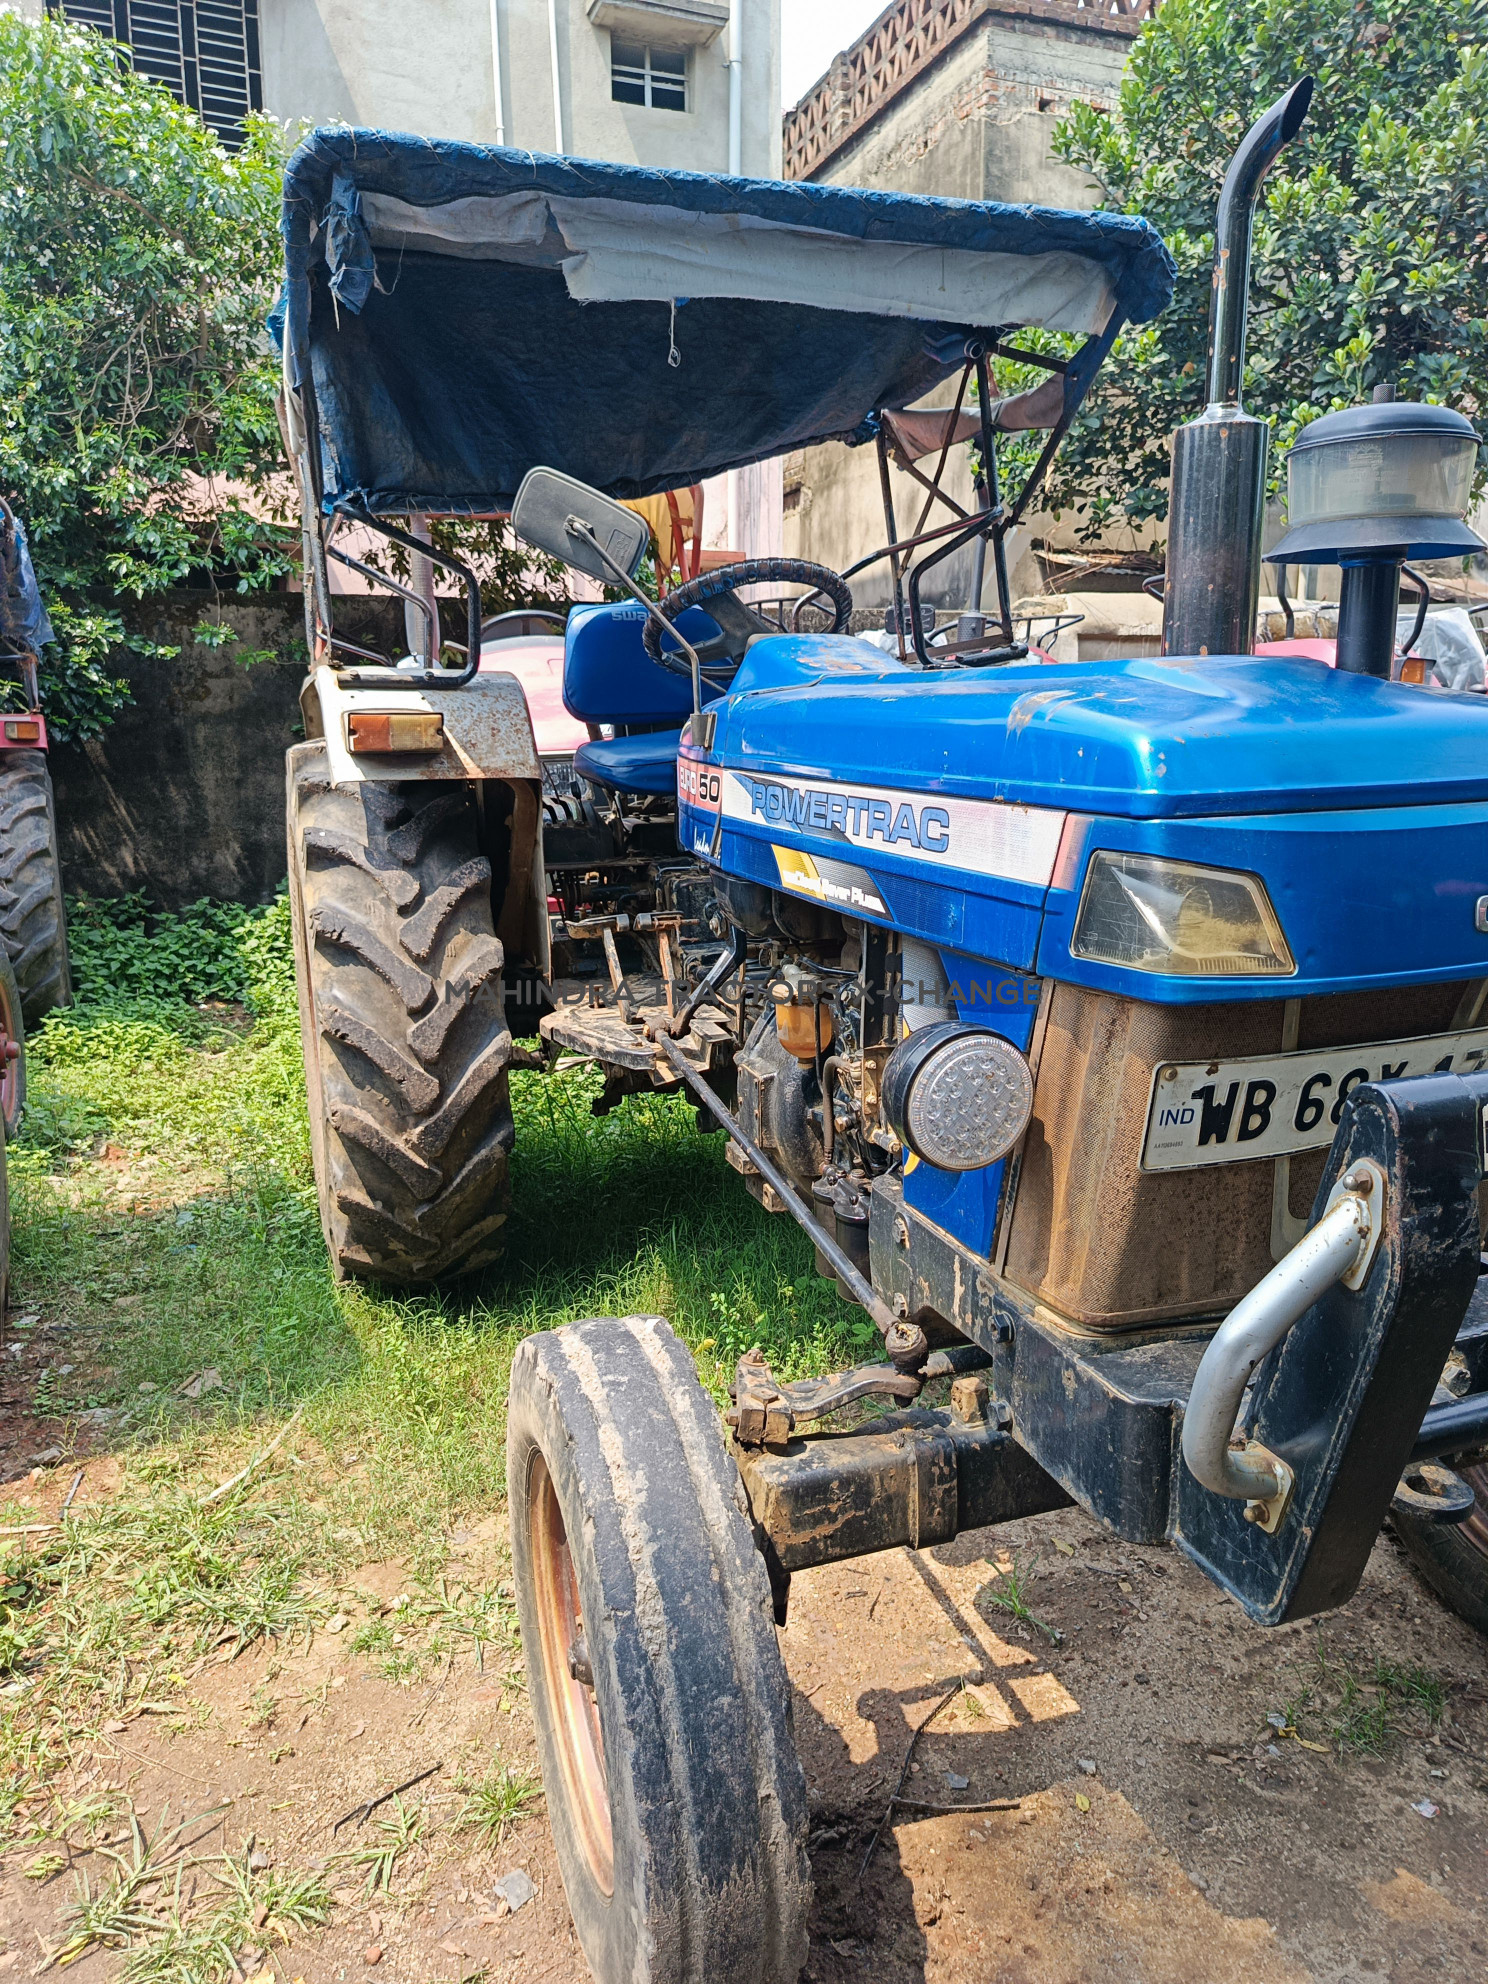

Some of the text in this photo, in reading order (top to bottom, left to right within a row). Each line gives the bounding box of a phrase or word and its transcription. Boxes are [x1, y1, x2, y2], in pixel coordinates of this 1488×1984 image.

[699, 772, 721, 804] 50
[752, 783, 950, 853] POWERTRAC
[1159, 1108, 1195, 1127] IND
[1190, 1080, 1277, 1146] WB
